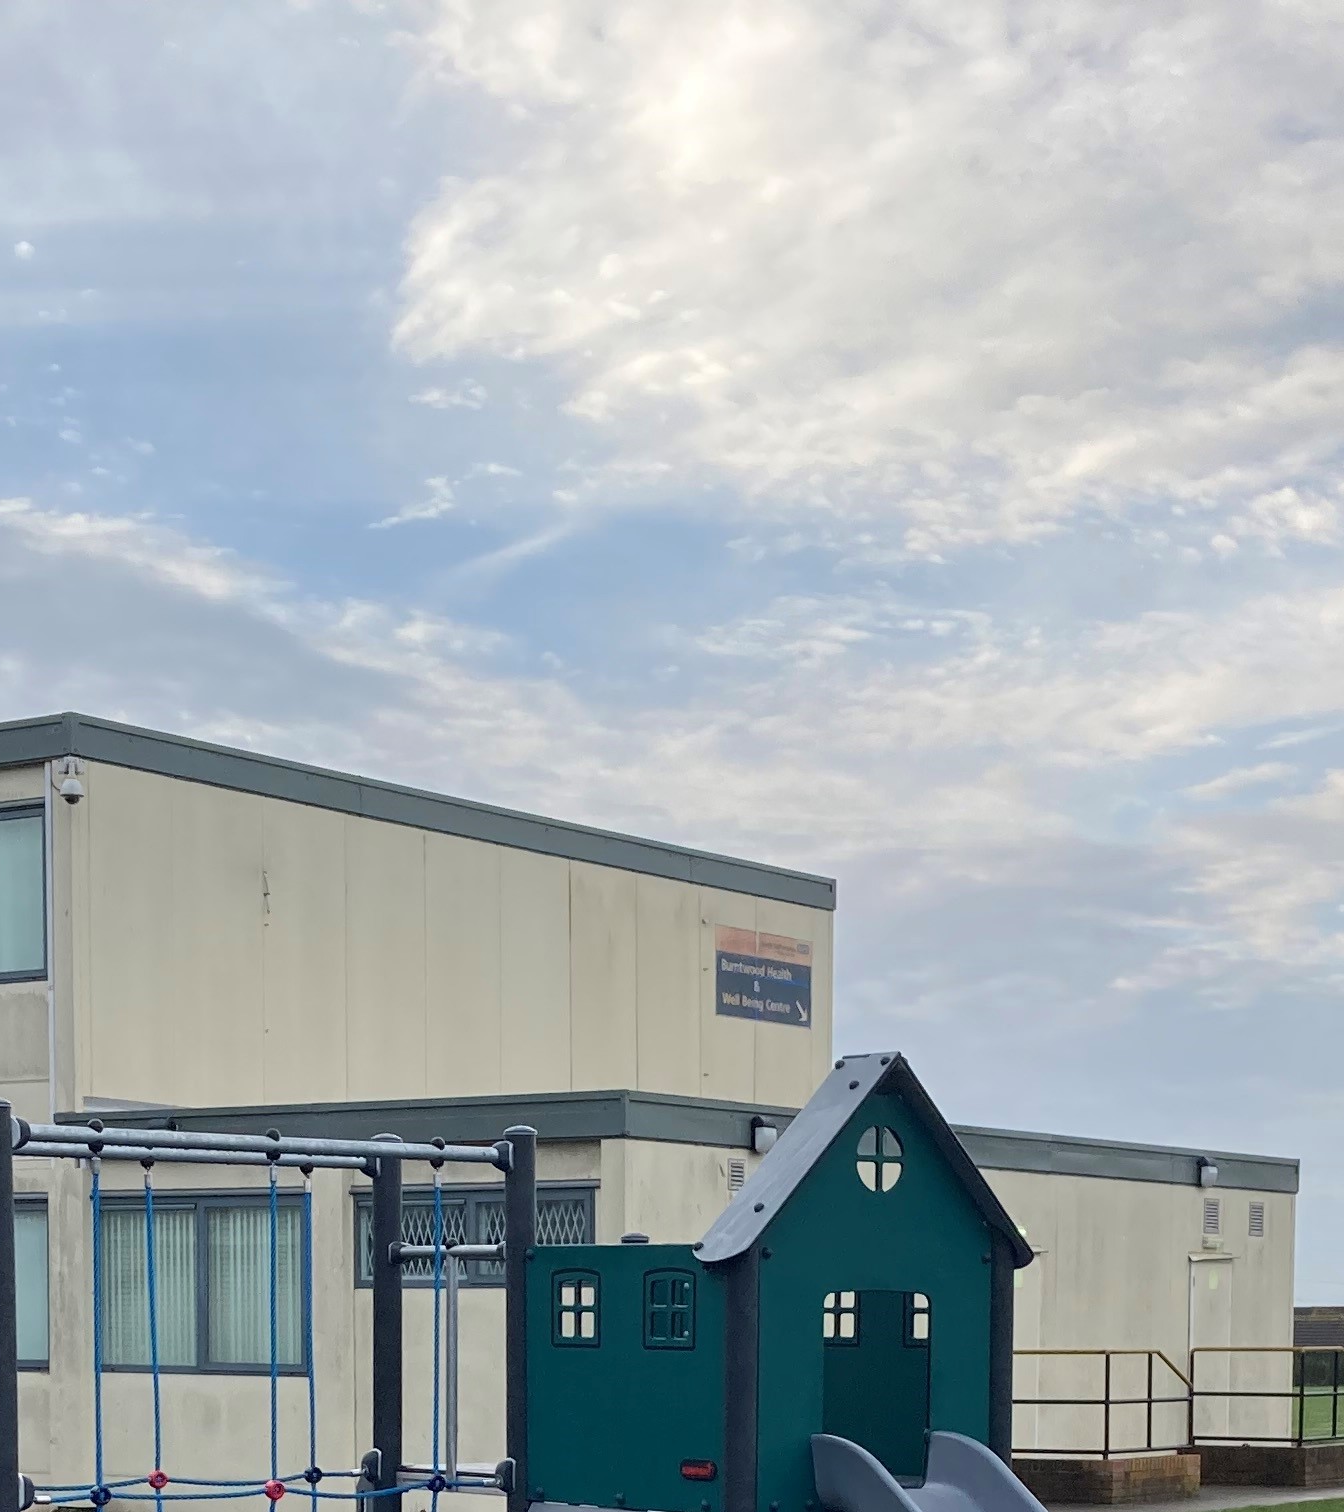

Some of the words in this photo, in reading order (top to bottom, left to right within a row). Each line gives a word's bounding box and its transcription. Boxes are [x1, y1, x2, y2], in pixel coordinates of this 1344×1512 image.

[721, 957, 765, 977] Burntwood
[767, 966, 792, 981] Health
[753, 980, 760, 992] &
[722, 992, 740, 1006] Well
[742, 994, 764, 1012] Being
[766, 999, 791, 1014] Centre
